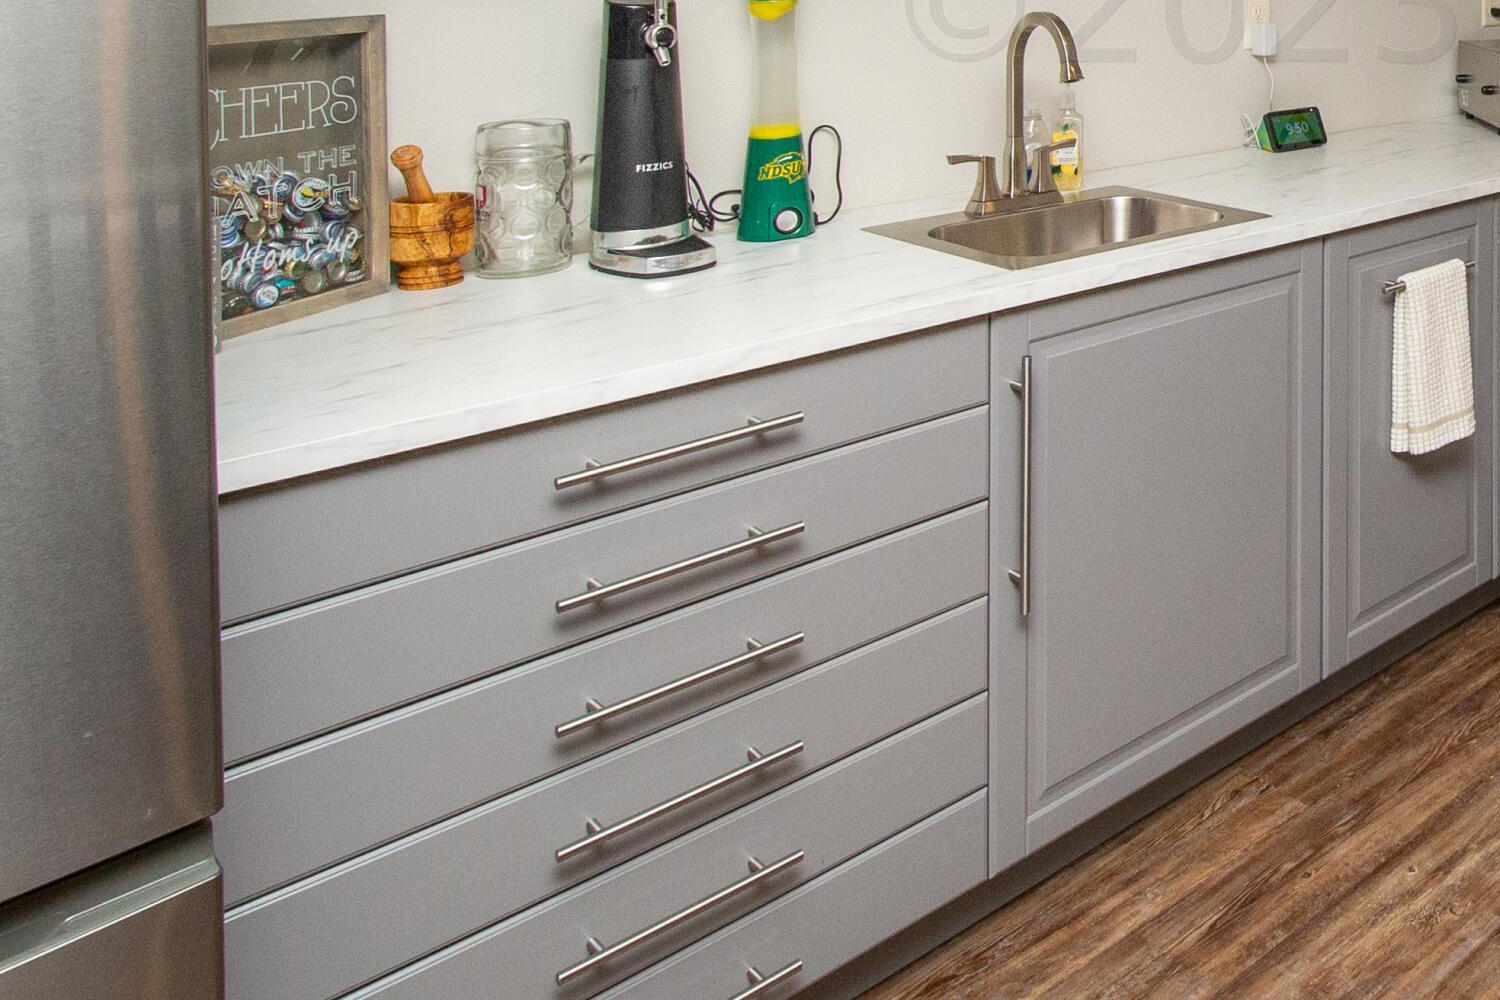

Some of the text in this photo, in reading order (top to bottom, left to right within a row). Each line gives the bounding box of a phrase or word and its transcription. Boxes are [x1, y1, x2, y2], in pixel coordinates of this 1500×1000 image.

[211, 144, 357, 190] OWN THE
[635, 161, 674, 173] FIZZICS
[758, 160, 801, 181] NDSU
[221, 226, 361, 281] ottoms up
